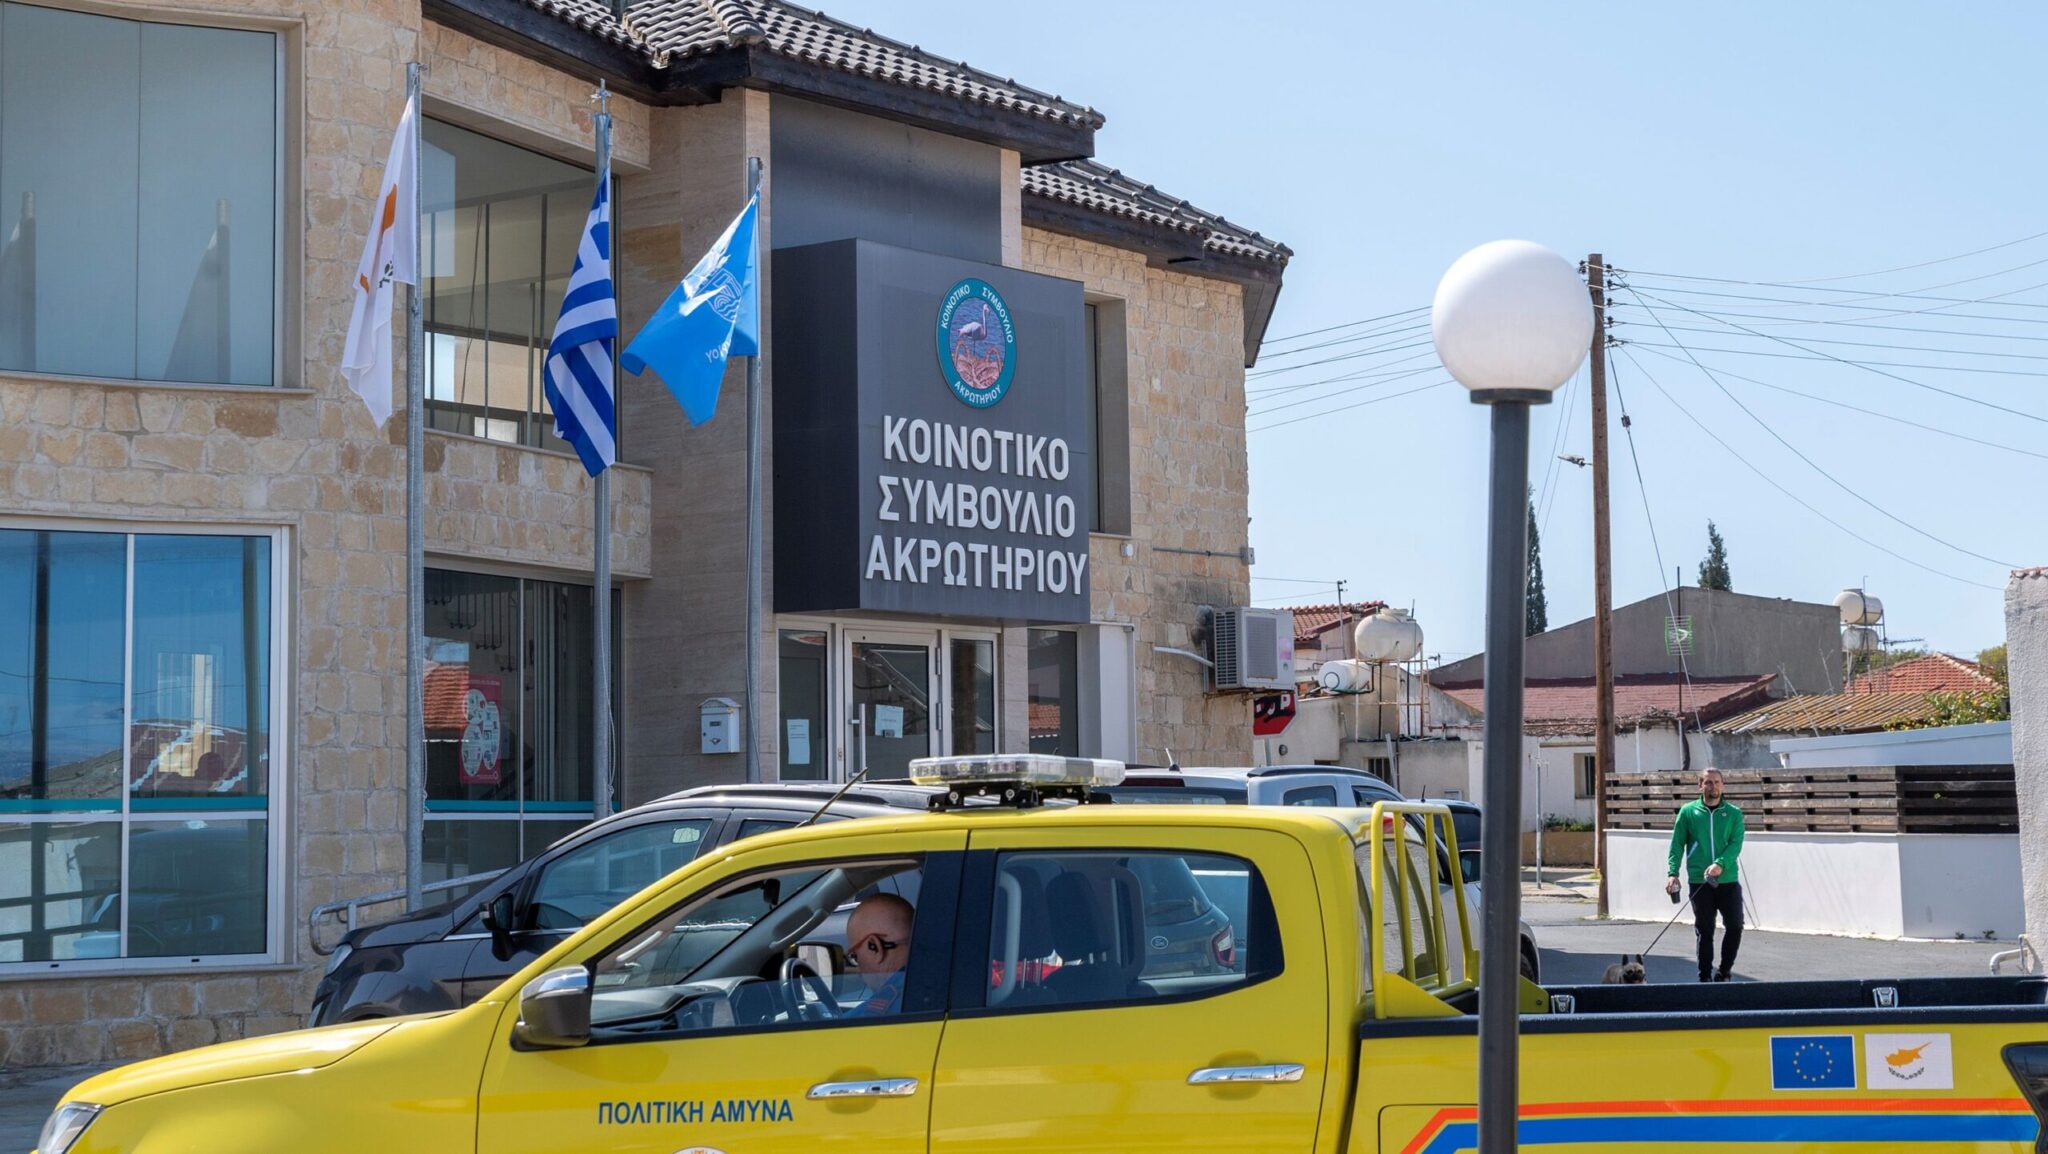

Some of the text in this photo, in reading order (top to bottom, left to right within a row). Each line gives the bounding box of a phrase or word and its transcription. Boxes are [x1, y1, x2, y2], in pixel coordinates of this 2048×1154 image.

[941, 284, 1013, 343] ΚΟΙΝΟΤΙΚΟ ΣΥΜΒΟΥΛΙΟ
[954, 381, 1002, 404] ΑΚΡΩΤΗΡΙΟΥ
[883, 415, 1069, 481] ΚΟΙΝΟΤΙΚΟ
[878, 475, 1075, 538] ΣΥΜΒΟΥΛΙΟ
[865, 535, 1087, 594] ΑΚΡΩΤΗΡΙΟΥ
[598, 1099, 794, 1124] ΠΟΛΙΤΙΚΗ ΑΜΥΝΑ
